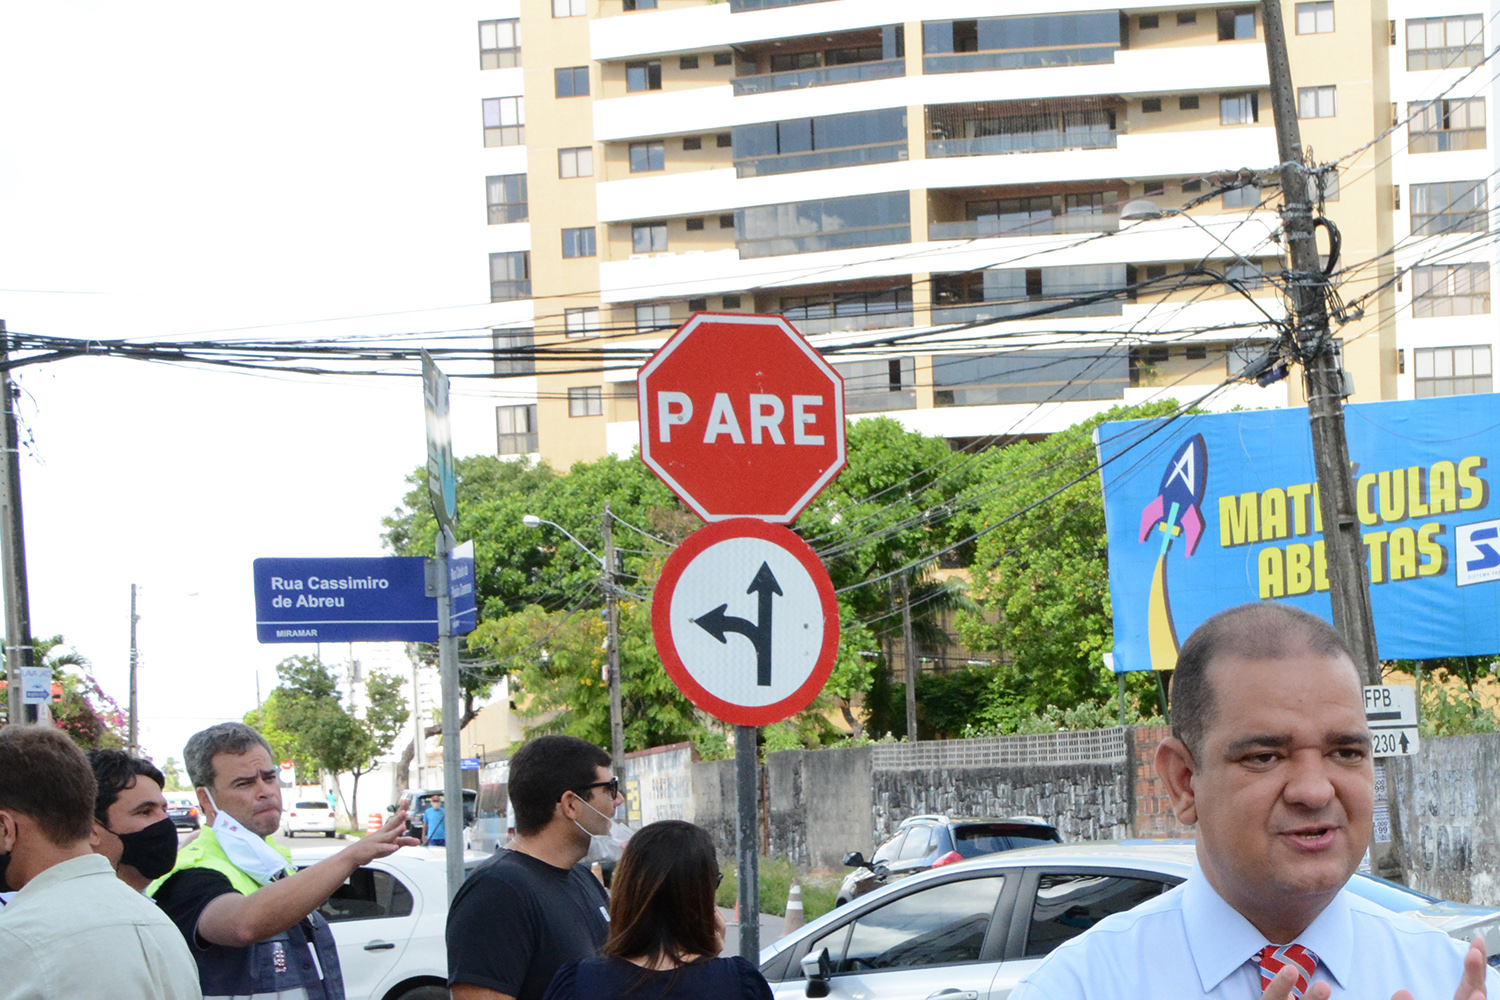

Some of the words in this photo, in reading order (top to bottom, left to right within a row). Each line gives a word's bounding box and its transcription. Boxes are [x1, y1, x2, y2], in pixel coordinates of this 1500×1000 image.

[657, 391, 825, 446] PARE
[1218, 455, 1488, 548] MATCULAS
[1258, 522, 1447, 599] ABETAS
[271, 577, 304, 590] Rua
[307, 576, 389, 590] Cassimiro
[272, 595, 292, 608] de
[296, 595, 345, 608] Abreu
[276, 629, 318, 638] MIRAMAR
[1374, 733, 1396, 754] 230
[1413, 769, 1480, 817] ESTA
